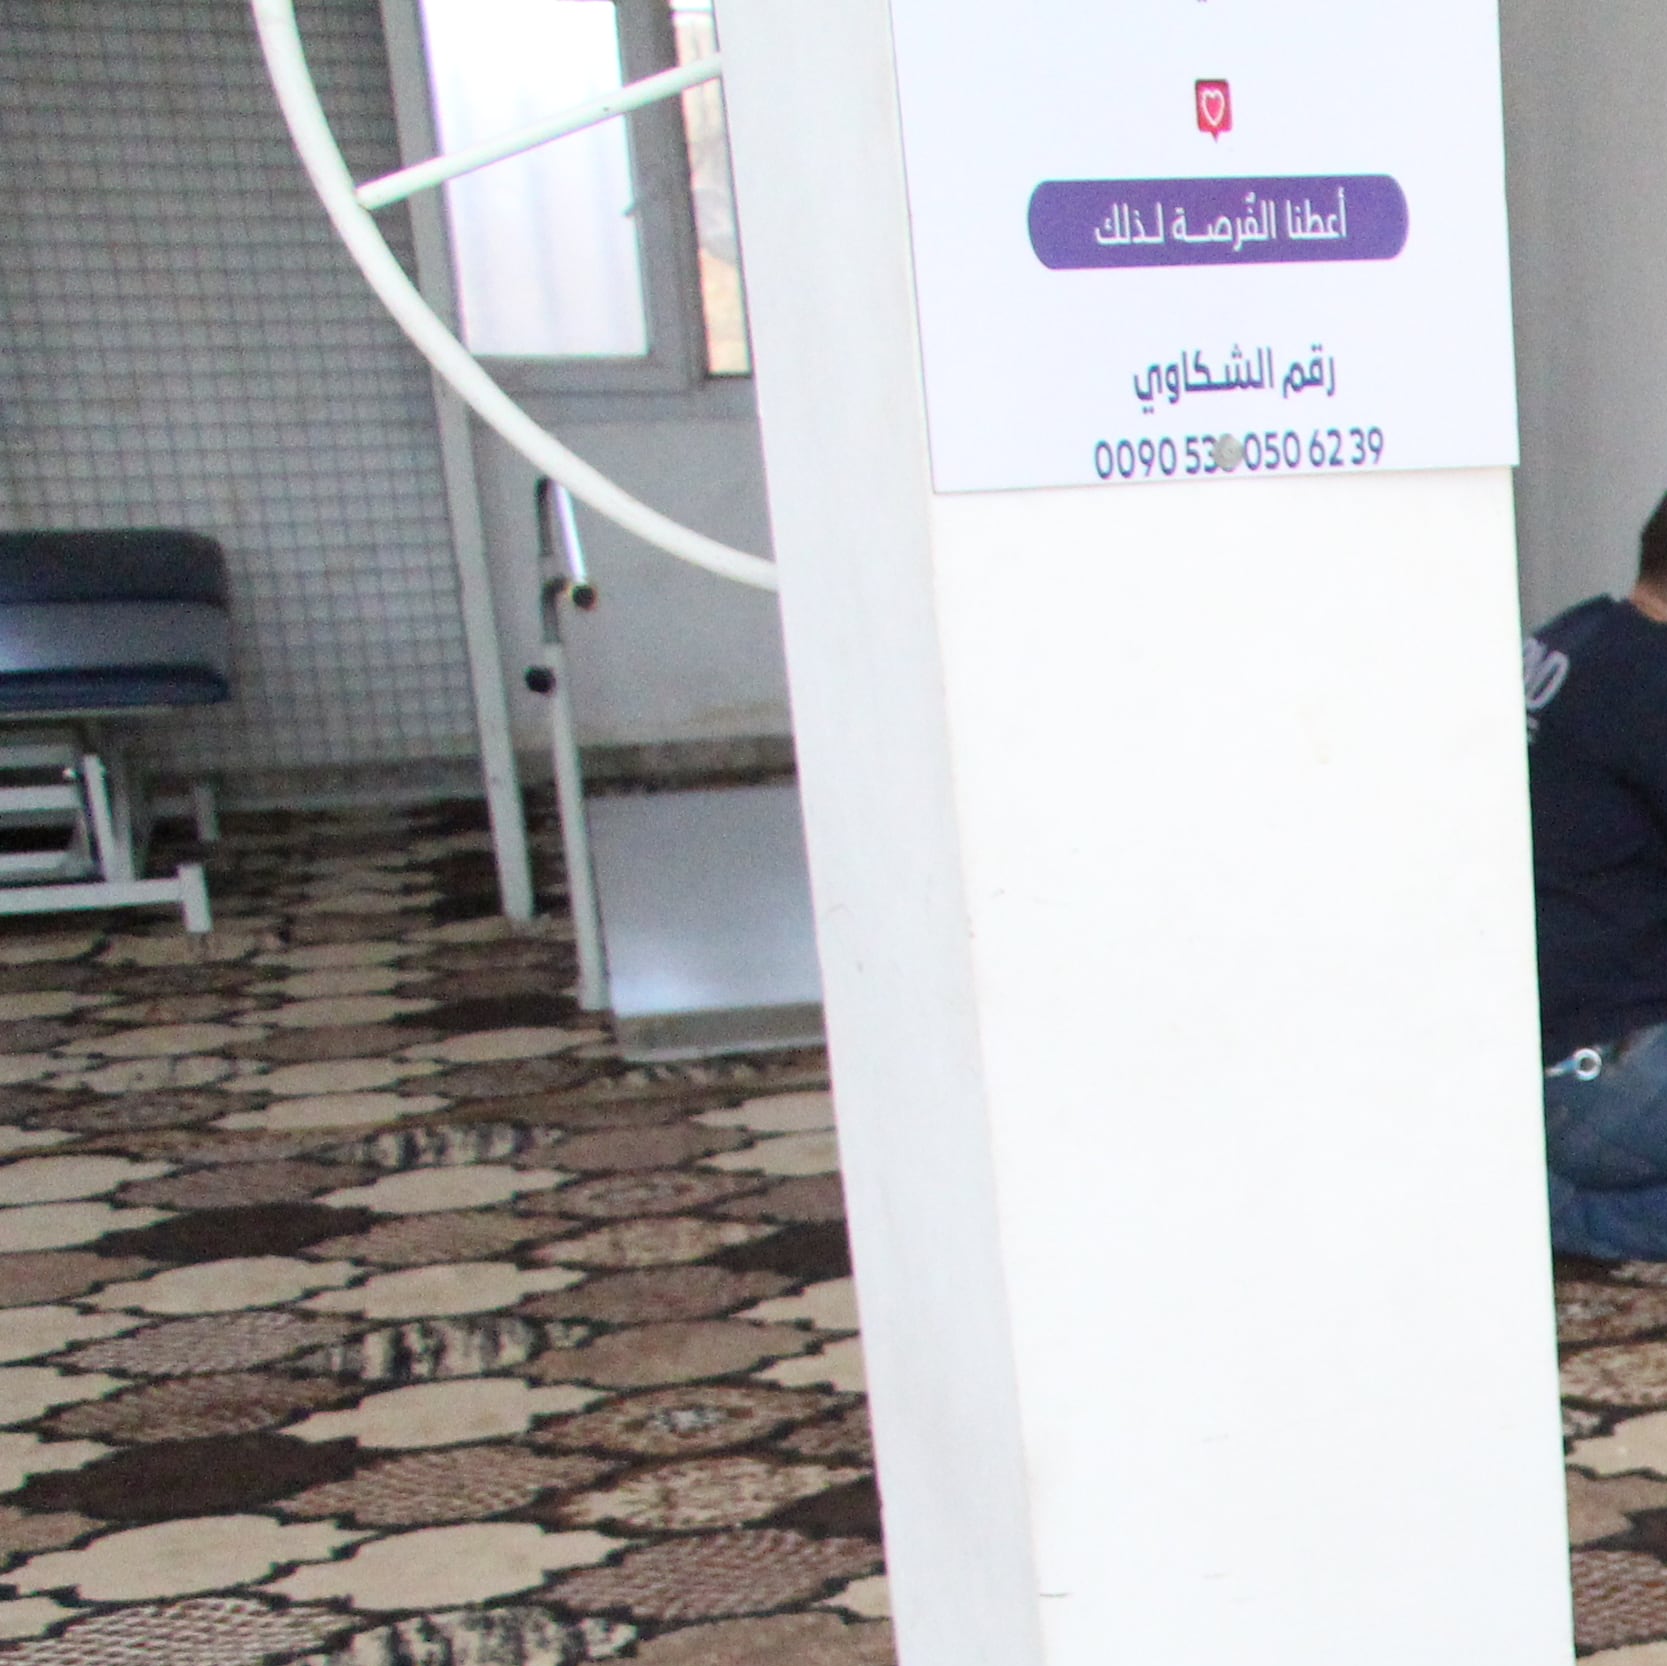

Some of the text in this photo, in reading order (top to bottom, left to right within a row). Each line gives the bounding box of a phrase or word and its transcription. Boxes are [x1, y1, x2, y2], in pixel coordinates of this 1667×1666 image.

[1285, 186, 1347, 240] أعطنا
[1133, 342, 1336, 415] رقم الشكاوي
[1094, 437, 1177, 480] 0090
[1184, 434, 1237, 475] 53
[1243, 429, 1302, 472] 050
